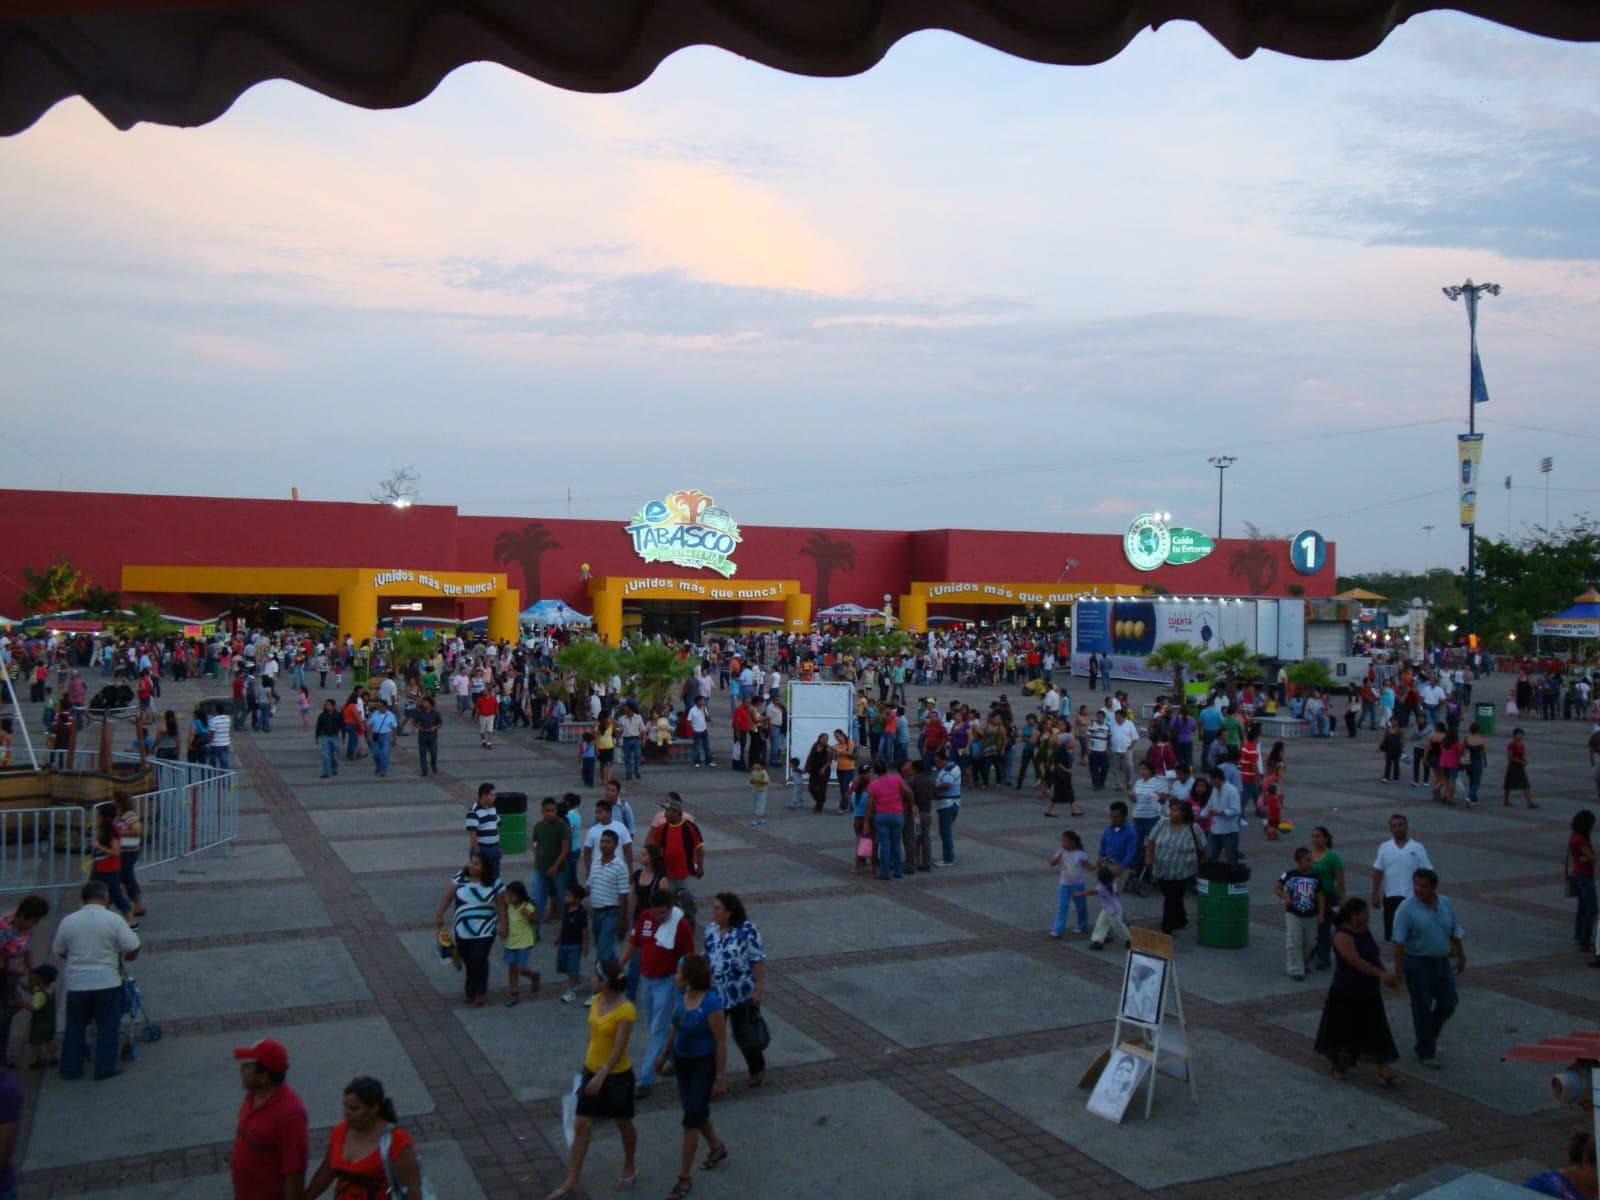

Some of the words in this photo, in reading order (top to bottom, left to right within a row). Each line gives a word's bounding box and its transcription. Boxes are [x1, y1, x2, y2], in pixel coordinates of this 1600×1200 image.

[627, 525, 735, 554] TABASCO
[1172, 535, 1194, 545] Cuida
[1182, 545, 1211, 554] Entorno
[1301, 536, 1316, 568] 1
[374, 569, 414, 588] ¡Unidos
[418, 574, 440, 590] más
[443, 584, 462, 597] que
[463, 576, 497, 595] nunca!
[624, 578, 673, 595] ¡Unidos
[679, 581, 705, 594] más
[710, 588, 734, 599] que
[737, 583, 784, 598] nunca!
[929, 582, 979, 598] ¡Unidos
[984, 585, 1013, 599] más
[1019, 592, 1043, 603] que
[1168, 617, 1192, 626] CUENTA
